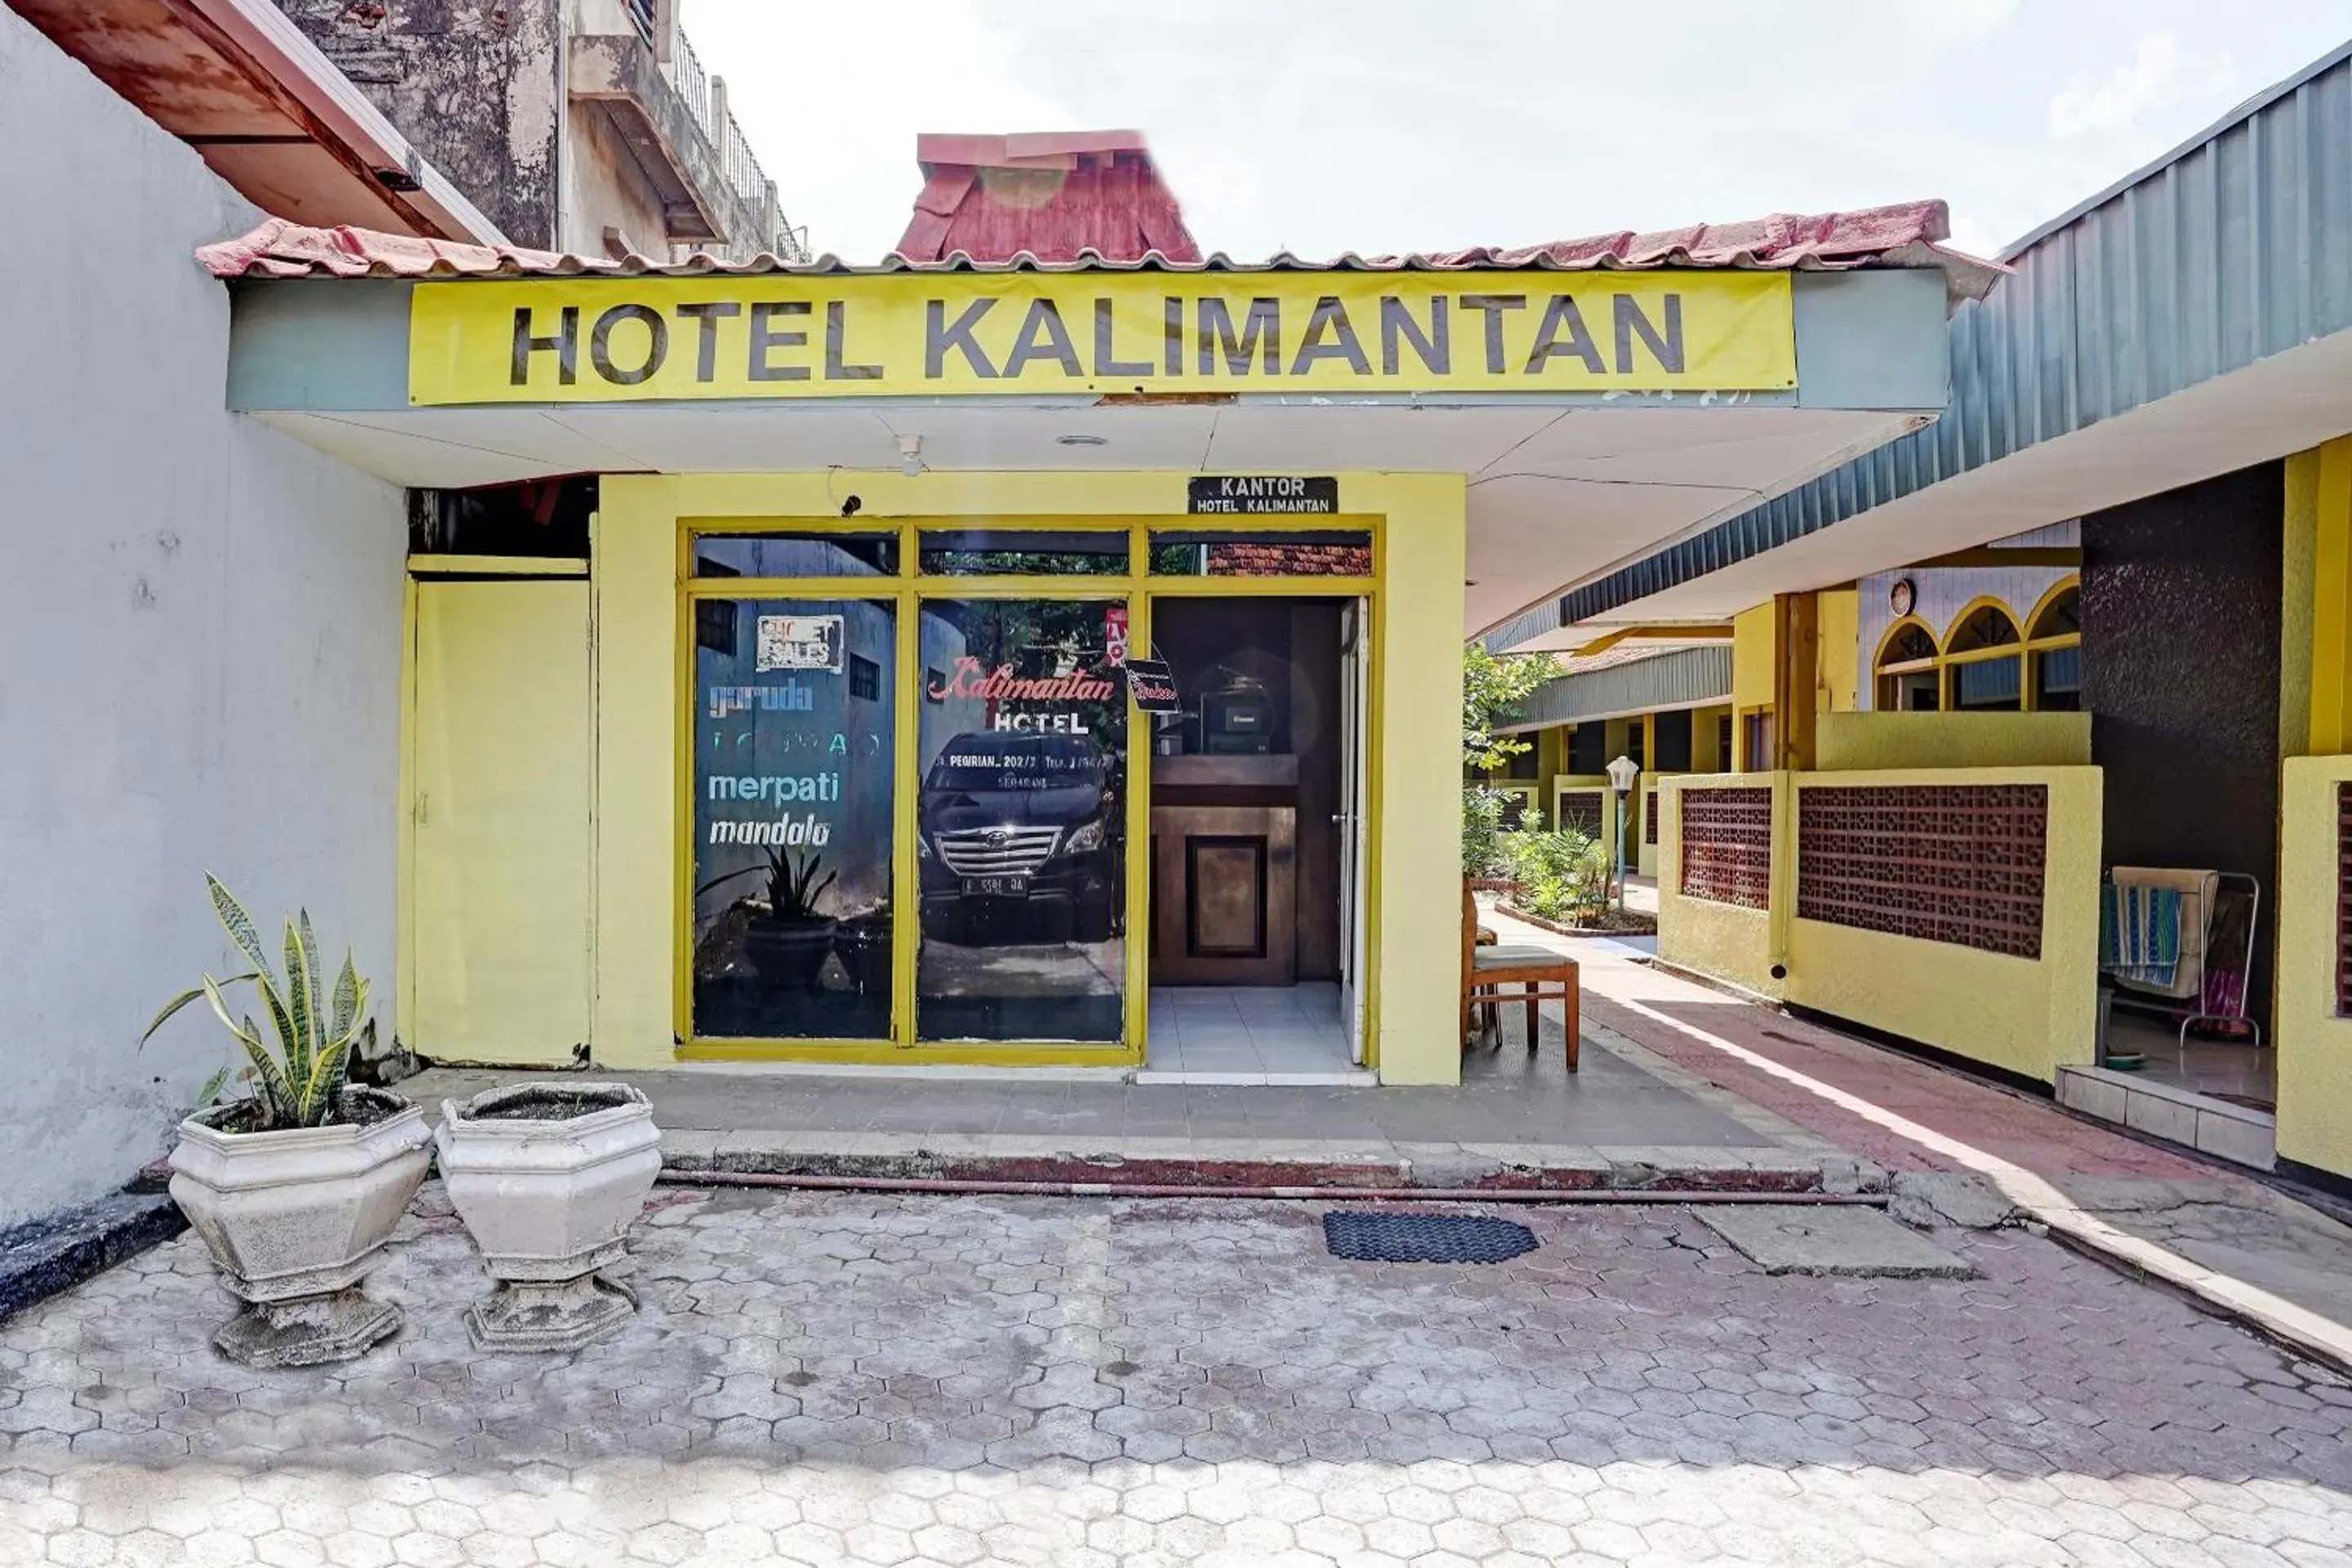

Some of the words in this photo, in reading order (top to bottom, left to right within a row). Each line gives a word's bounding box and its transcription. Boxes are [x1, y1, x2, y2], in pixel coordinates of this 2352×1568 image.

[510, 301, 884, 385] HOTEL
[924, 294, 1686, 378] KALIMANTAN
[1221, 478, 1305, 496] KANTOR
[1197, 500, 1238, 513] HOTEL
[1247, 499, 1329, 513] KALIMANTAN
[928, 656, 1116, 702] Kalimantan
[709, 677, 813, 719] garuda
[994, 712, 1089, 735] HOTEL
[708, 772, 840, 808] merpati
